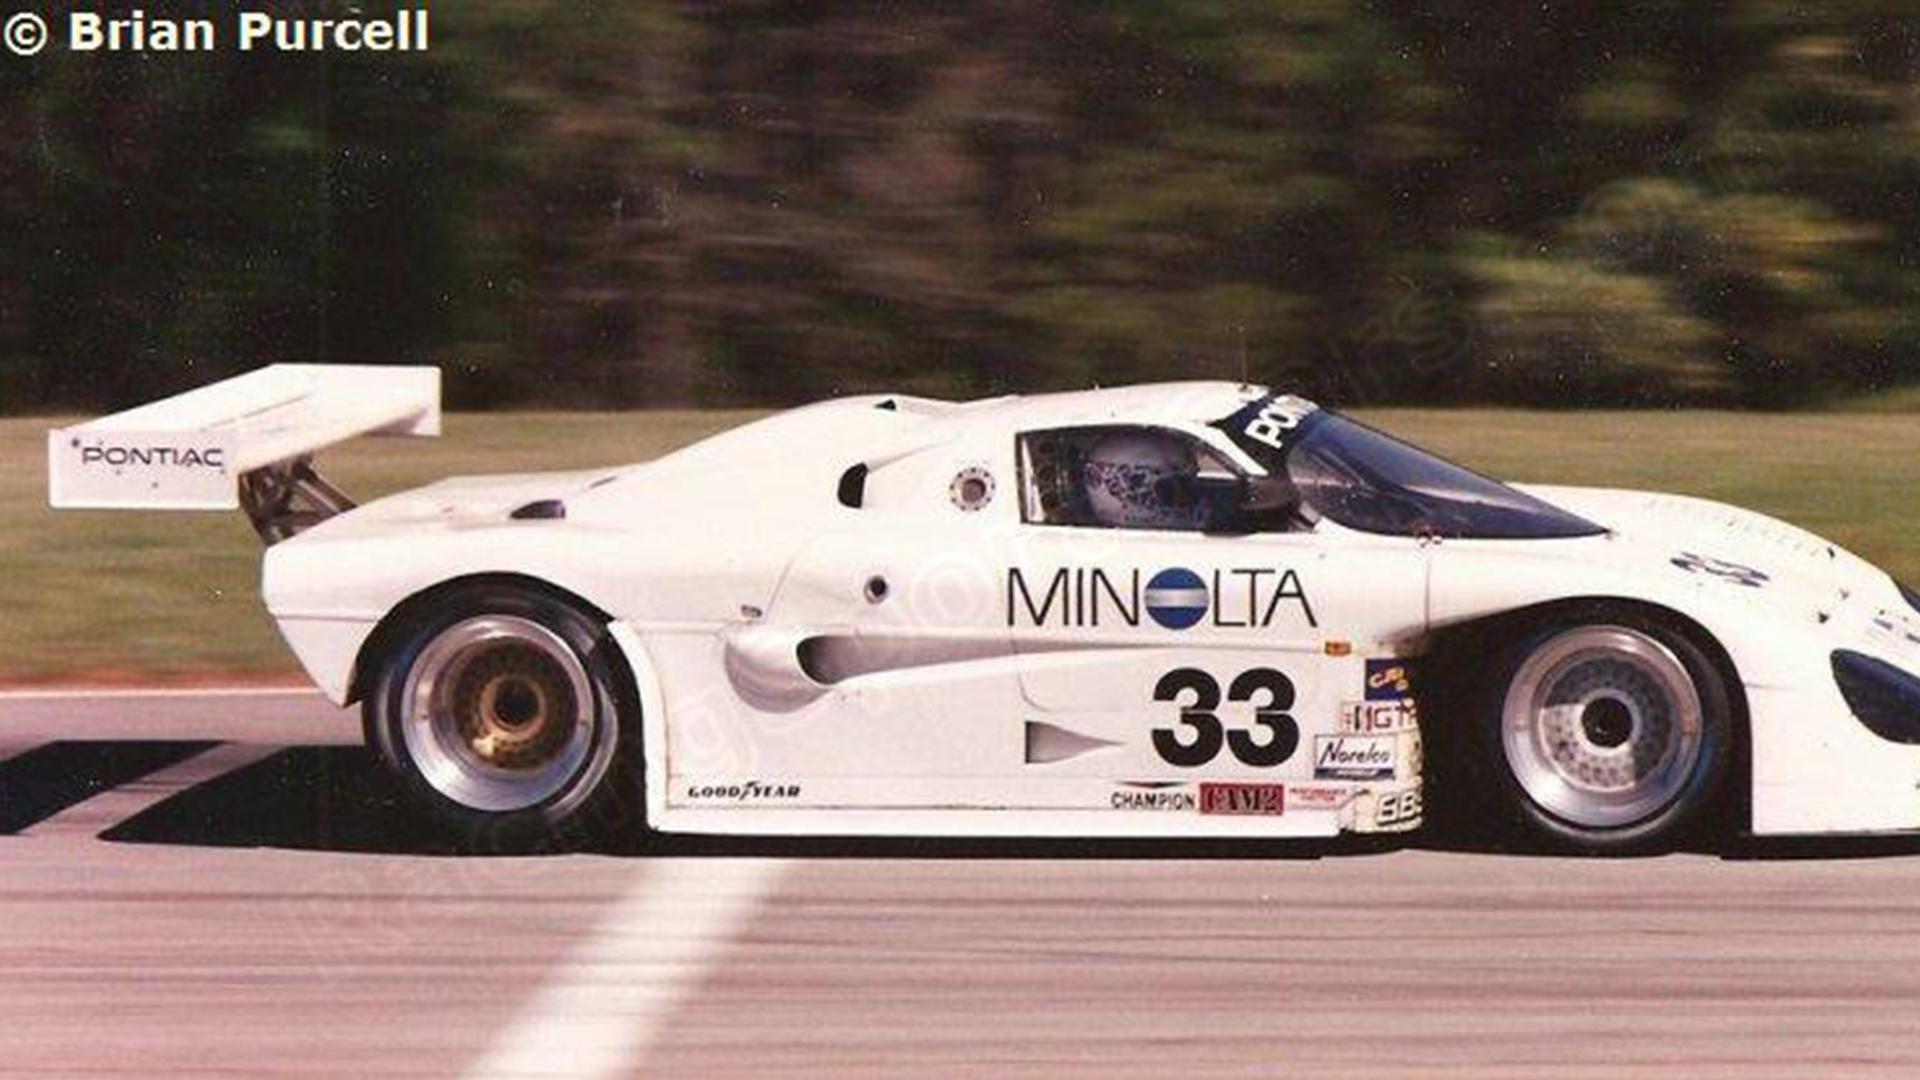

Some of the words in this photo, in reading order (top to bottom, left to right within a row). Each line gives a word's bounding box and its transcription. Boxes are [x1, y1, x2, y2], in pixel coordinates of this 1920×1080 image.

[82, 447, 224, 467] PONTIAC
[1007, 566, 1318, 630] MINOLTA
[1151, 667, 1300, 768] 33
[1318, 739, 1392, 766] Norelco
[688, 780, 801, 801] GOODYEAR
[1110, 791, 1195, 811] CHAMPION
